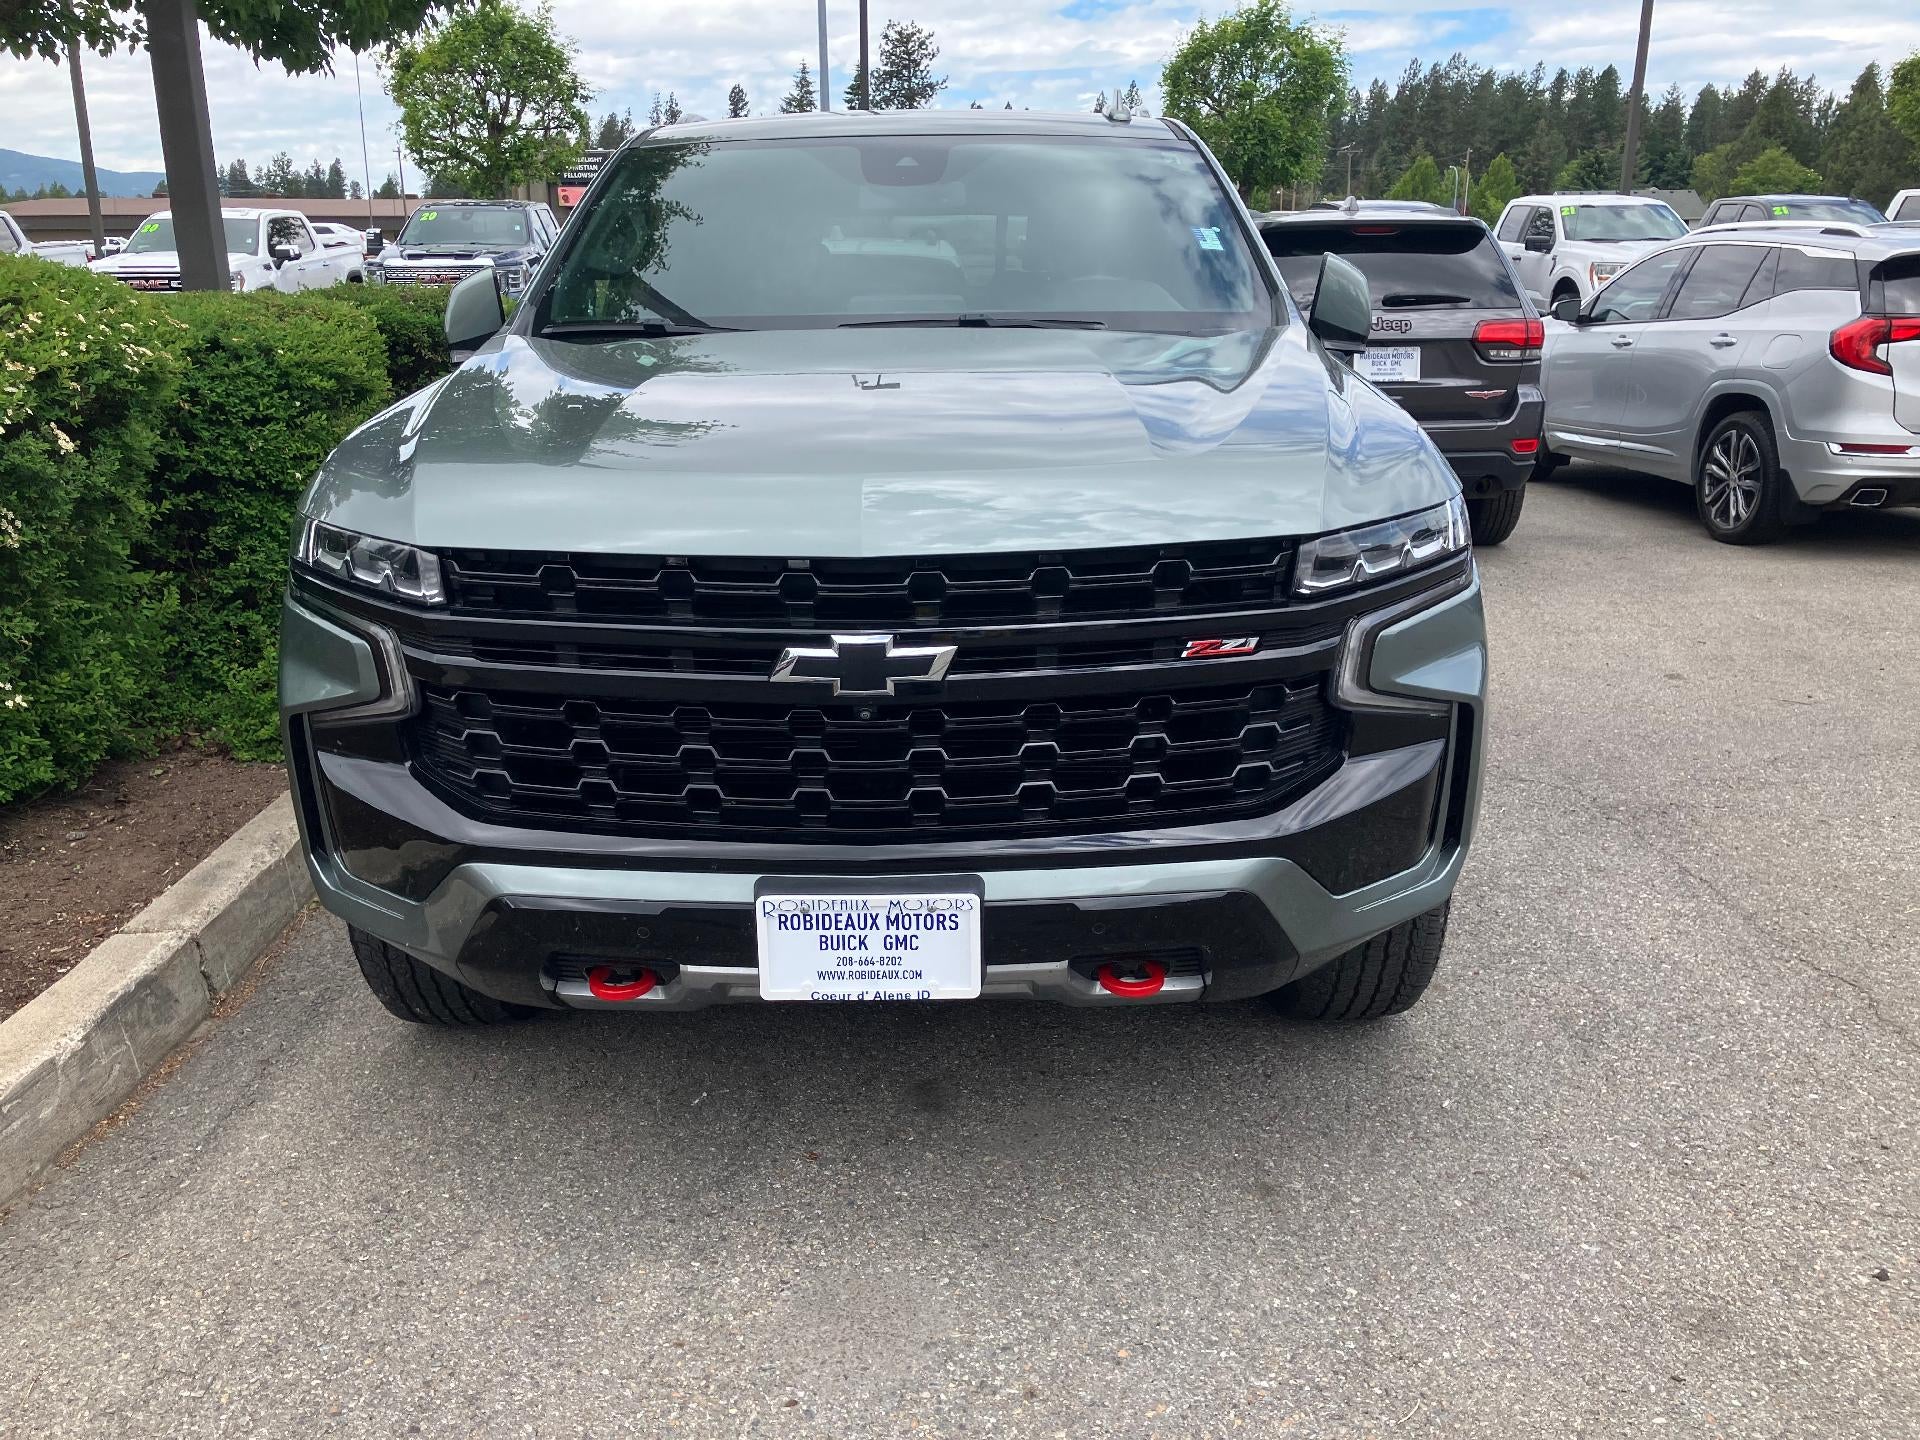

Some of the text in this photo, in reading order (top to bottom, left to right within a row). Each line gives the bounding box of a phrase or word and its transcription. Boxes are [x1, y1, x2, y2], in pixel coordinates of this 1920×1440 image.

[420, 211, 438, 221] 20
[1561, 206, 1577, 216] 21
[1772, 206, 1790, 216] 21
[141, 223, 160, 233] 20
[127, 280, 169, 288] GMC
[1371, 317, 1412, 333] Jeep
[1391, 352, 1415, 360] MOTORS
[1181, 637, 1260, 658] Z71
[778, 913, 959, 931] ROBIDEAUX MOTORS
[819, 934, 919, 951] BUICK GMC
[836, 956, 903, 967] 208-664-8202
[816, 970, 923, 980] WWW.ROBIDEAUX.COM
[811, 990, 852, 1000] Coeur
[873, 990, 912, 1000] Alene
[917, 990, 931, 1000] ID
